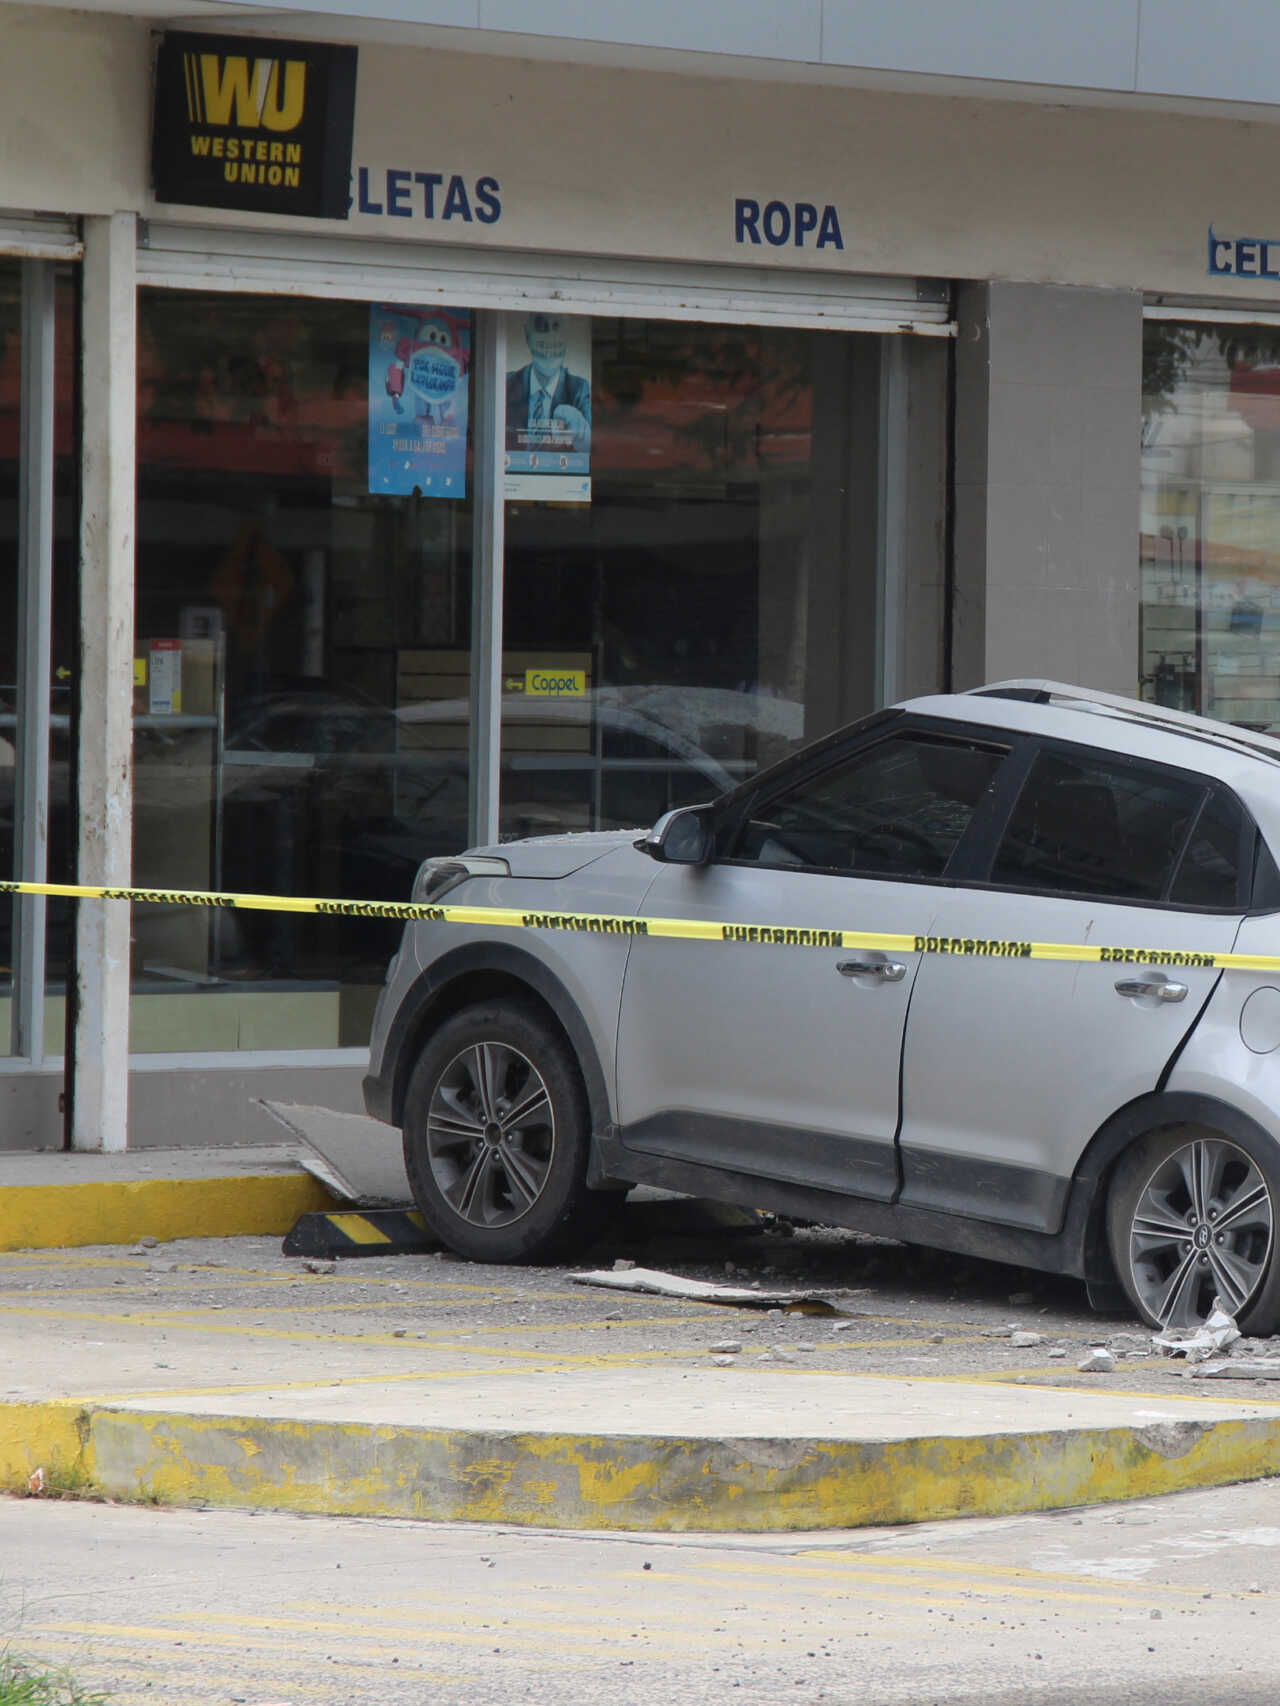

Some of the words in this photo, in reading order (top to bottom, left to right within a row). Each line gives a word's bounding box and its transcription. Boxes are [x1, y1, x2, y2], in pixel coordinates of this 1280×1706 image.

[186, 53, 307, 132] WU
[191, 135, 302, 163] WESTERN
[224, 162, 300, 187] UNION
[348, 166, 502, 225] LETAS
[735, 198, 845, 250] ROPA
[532, 674, 580, 696] Coppel
